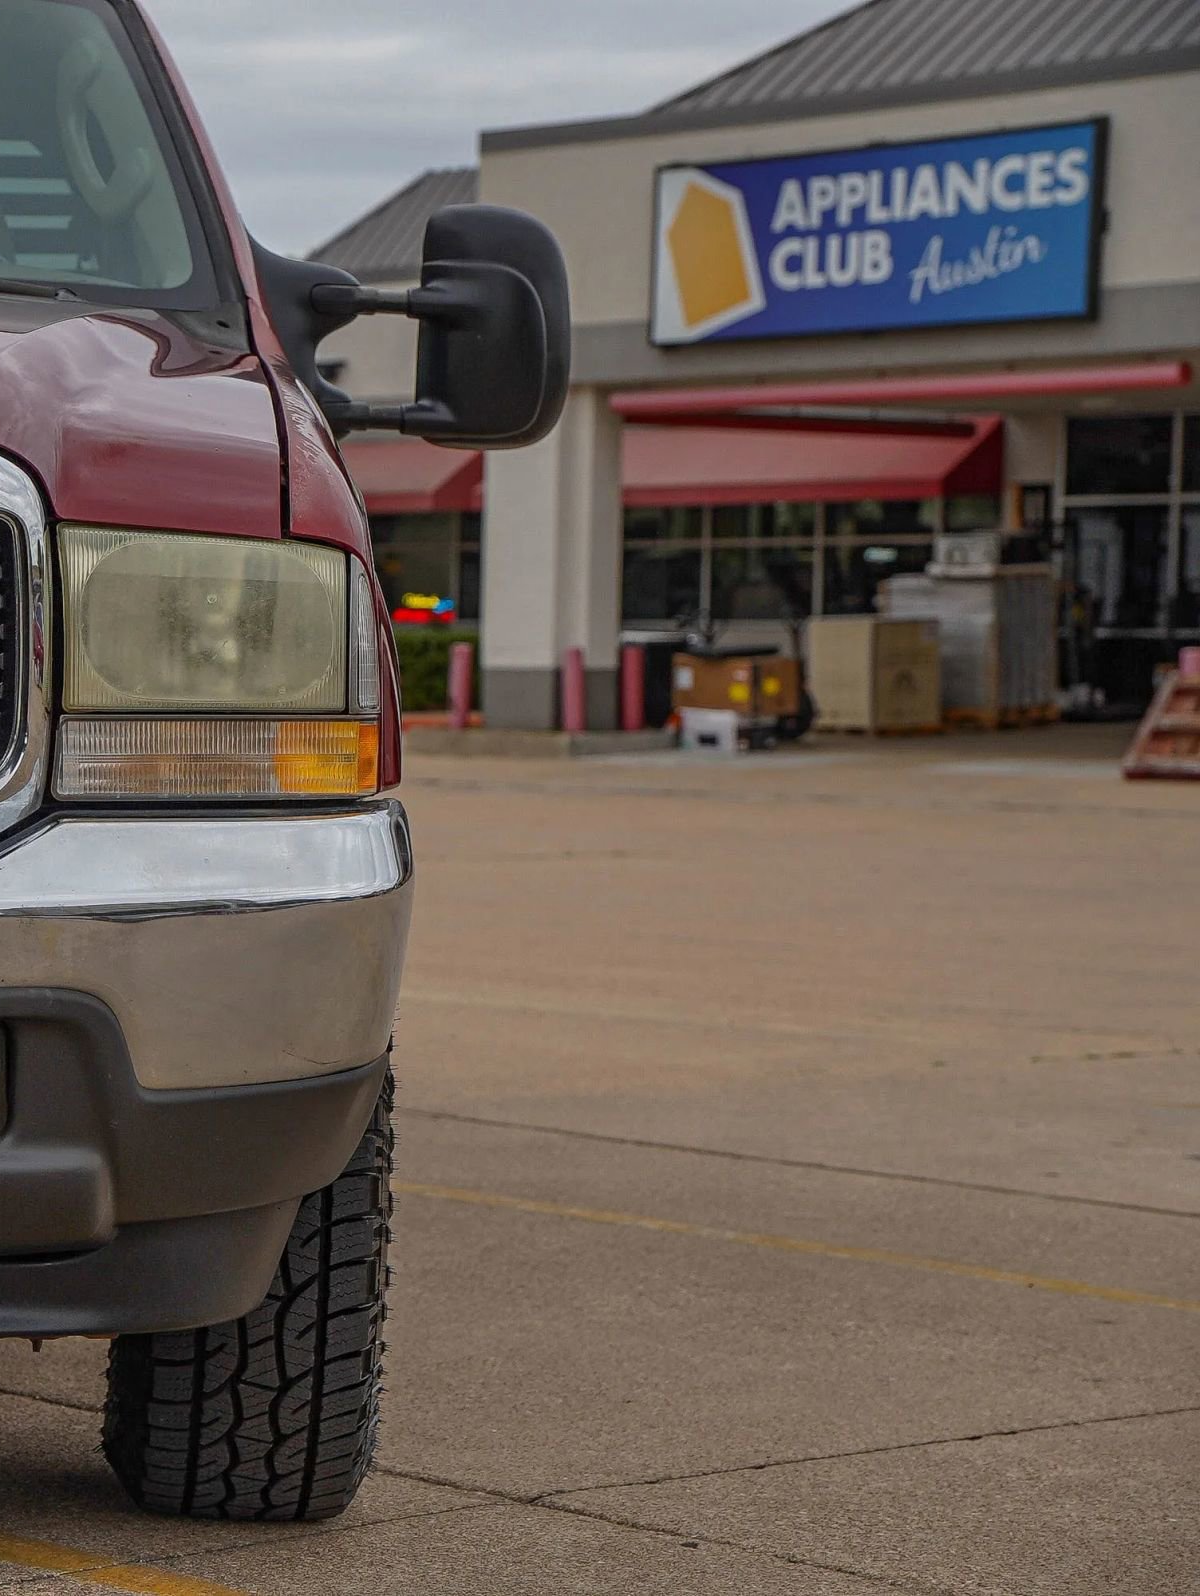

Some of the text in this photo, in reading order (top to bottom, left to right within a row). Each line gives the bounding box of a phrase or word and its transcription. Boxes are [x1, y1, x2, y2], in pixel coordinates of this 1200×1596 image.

[772, 147, 1089, 230] APPLIANCES
[769, 226, 1044, 303] CLUB Austin
